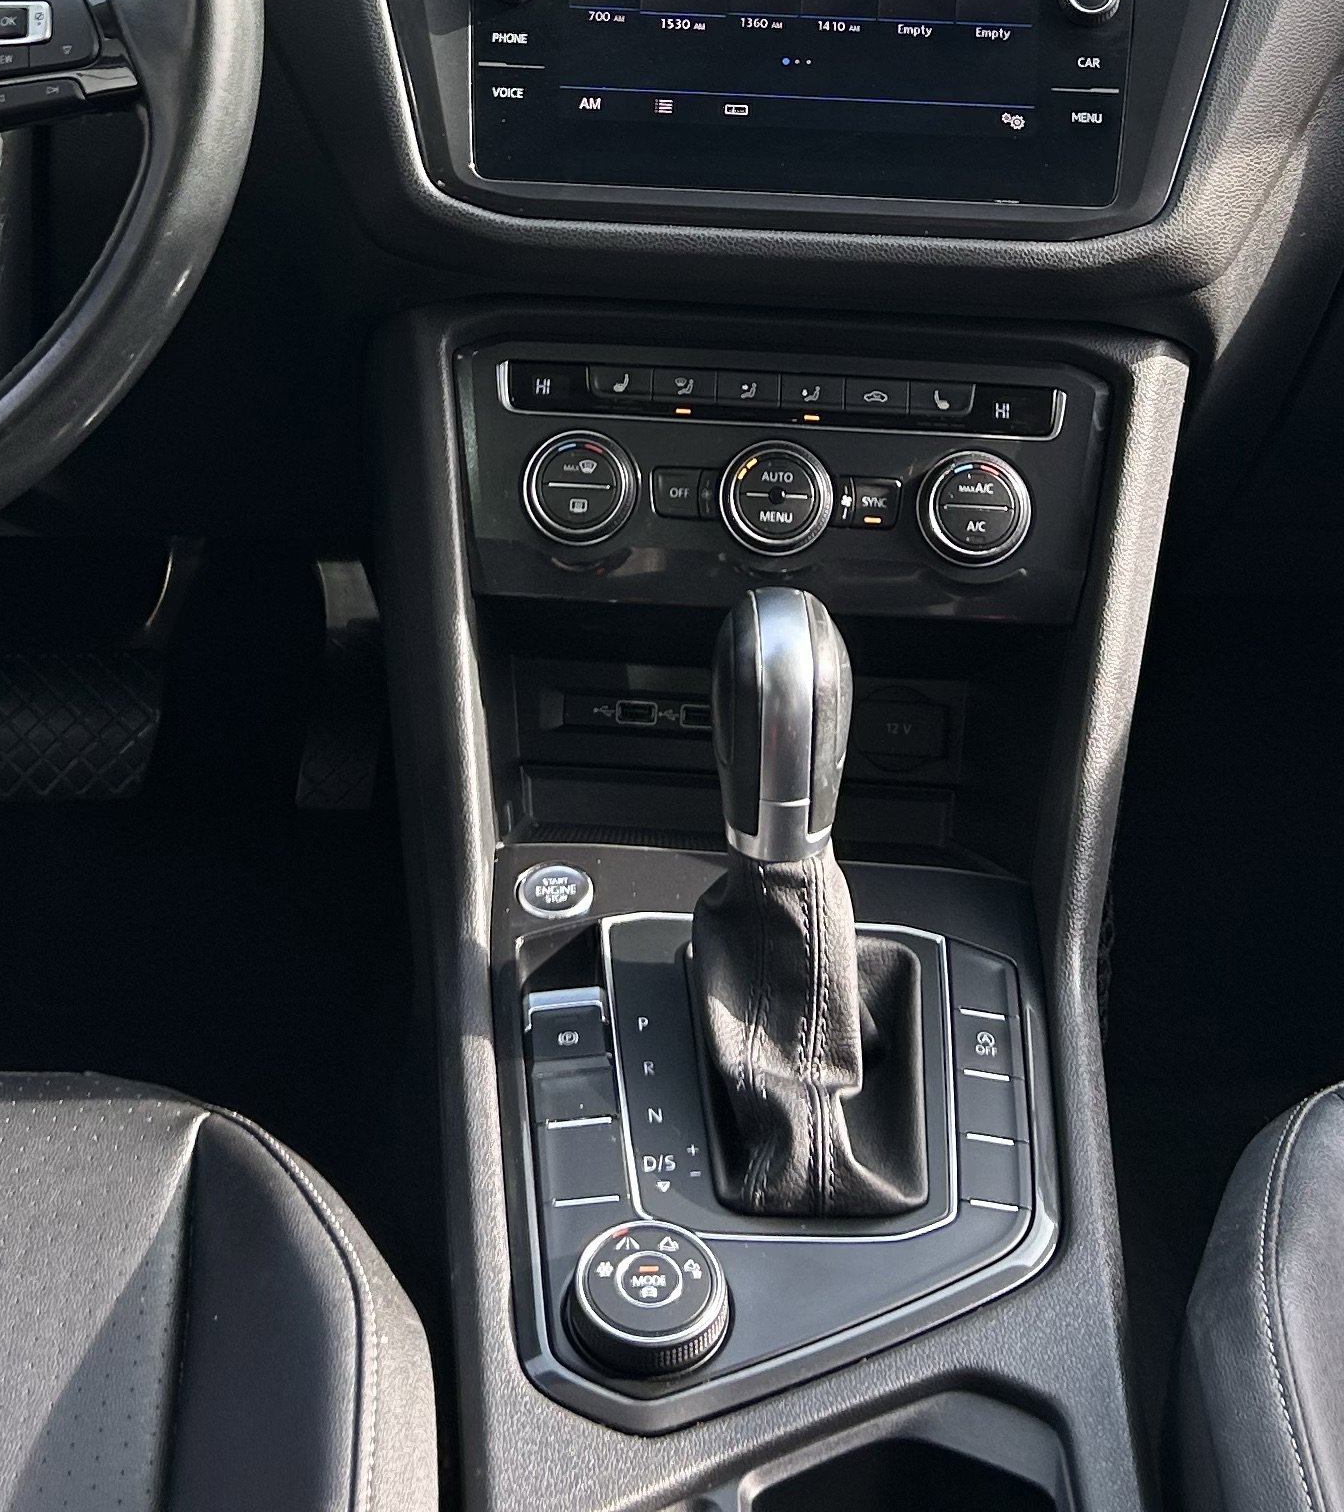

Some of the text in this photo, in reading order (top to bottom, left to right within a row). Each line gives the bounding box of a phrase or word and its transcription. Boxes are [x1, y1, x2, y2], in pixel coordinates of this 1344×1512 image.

[0, 16, 18, 27] OK
[588, 11, 611, 23] 700
[661, 18, 691, 30] 1530
[740, 18, 769, 29] 1360
[817, 20, 846, 32] 1410
[897, 24, 933, 38] Empty
[975, 26, 1011, 41] Empty
[491, 32, 528, 44] PHONE
[1077, 57, 1101, 69] CAR
[492, 86, 525, 99] VOICE
[578, 97, 602, 110] AM
[1071, 112, 1103, 124] MENU
[536, 378, 551, 395] HI
[995, 402, 1010, 419] HI
[761, 471, 794, 483] AUTO
[670, 487, 690, 498] OFF
[861, 496, 888, 508] SYNC
[759, 510, 793, 523] MENU
[966, 521, 986, 532] A/C
[903, 723, 912, 735] V
[542, 876, 569, 886] START
[536, 884, 576, 897] ENGINE
[638, 1016, 649, 1032] P
[975, 1044, 997, 1057] OFF
[643, 1061, 655, 1076] R
[647, 1107, 663, 1124] N
[642, 1153, 676, 1173] D/S
[631, 1275, 667, 1287] MODE
